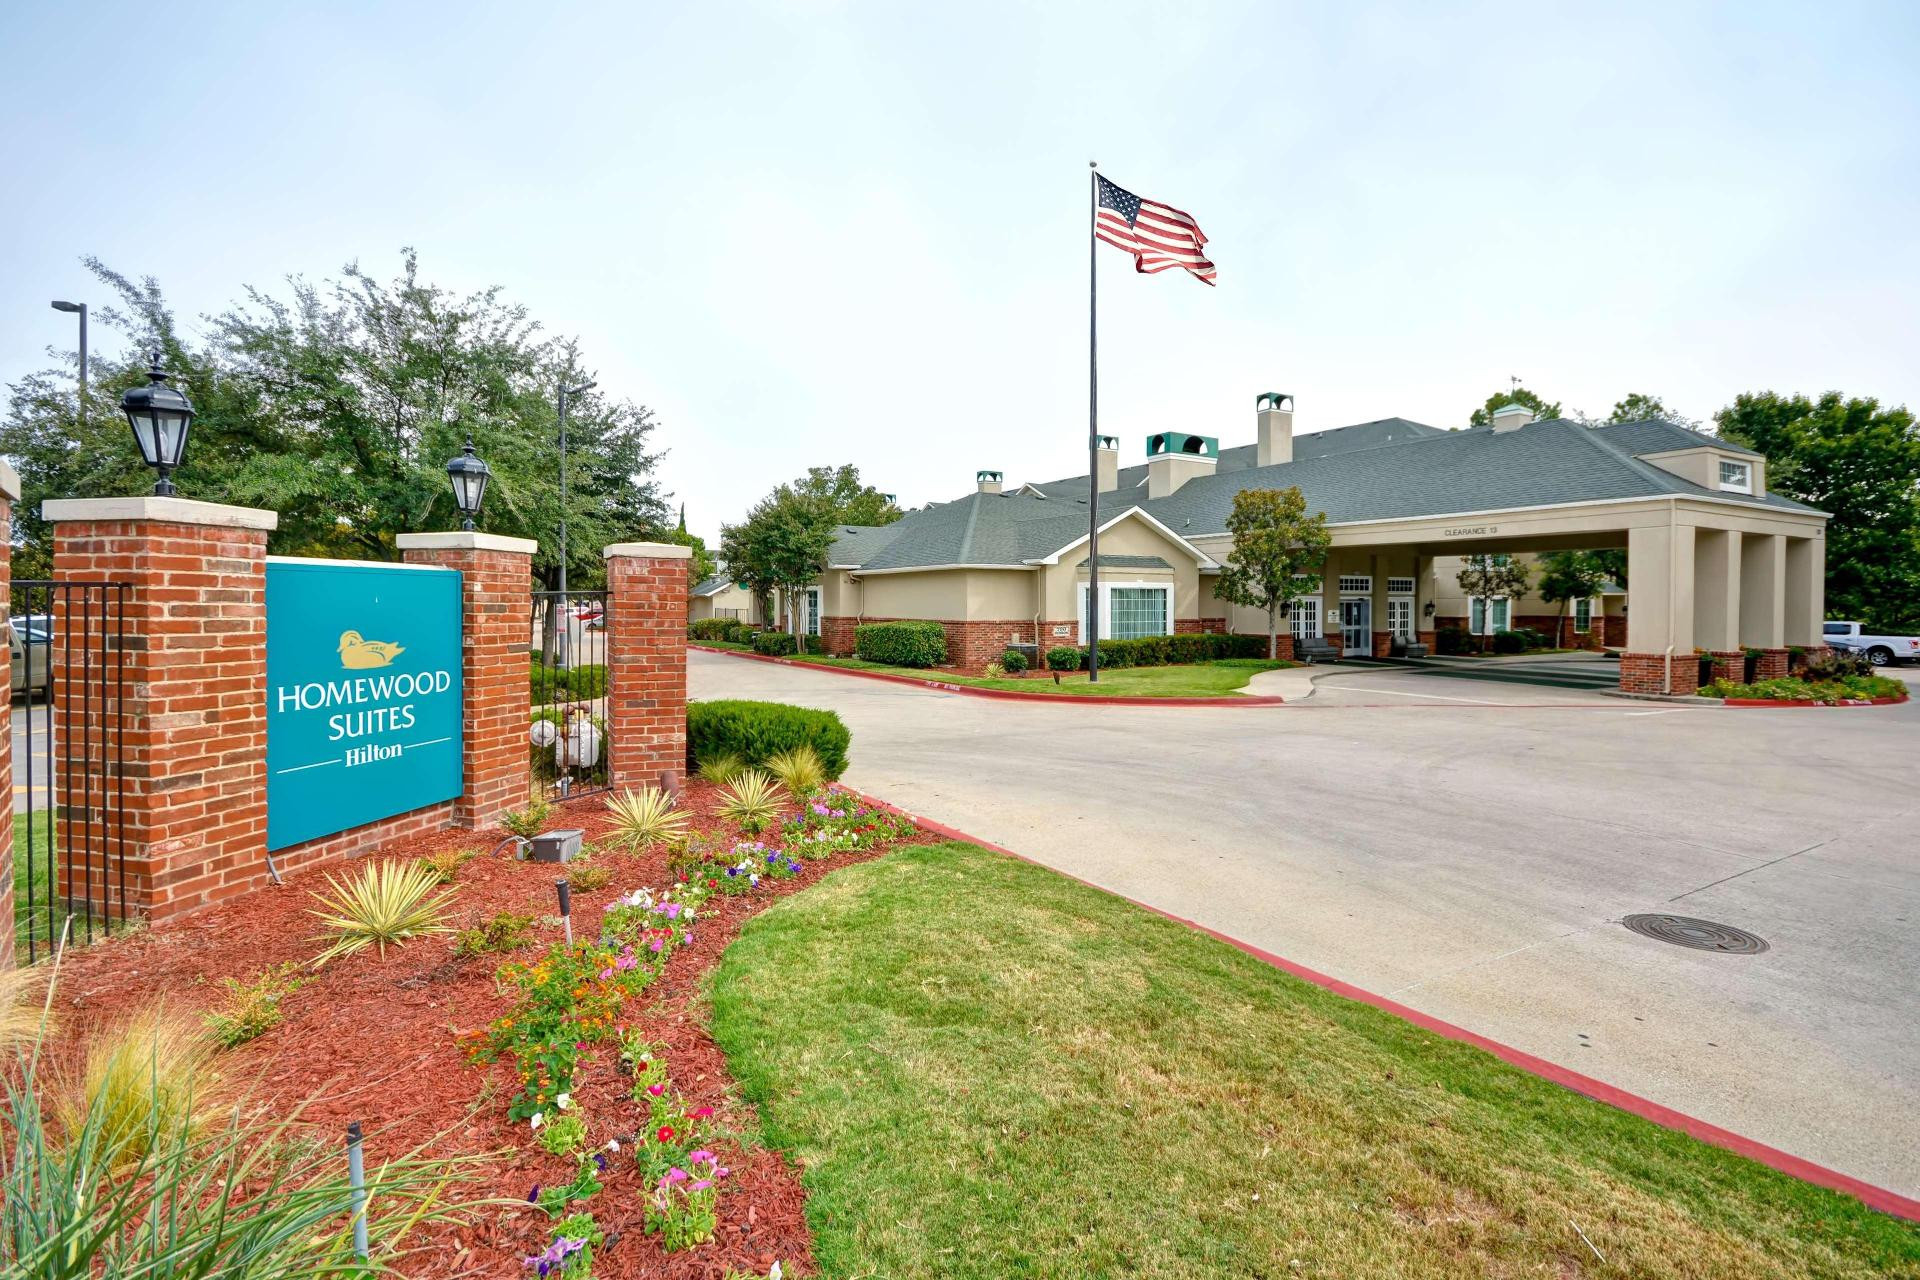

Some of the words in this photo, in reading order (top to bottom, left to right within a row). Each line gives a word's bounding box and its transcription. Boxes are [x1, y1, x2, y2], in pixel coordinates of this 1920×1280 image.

[1444, 527, 1487, 536] CLEARANCE
[278, 670, 451, 713] HOMEWOOD
[328, 704, 416, 741] SUITES
[344, 743, 403, 767] Hilton
